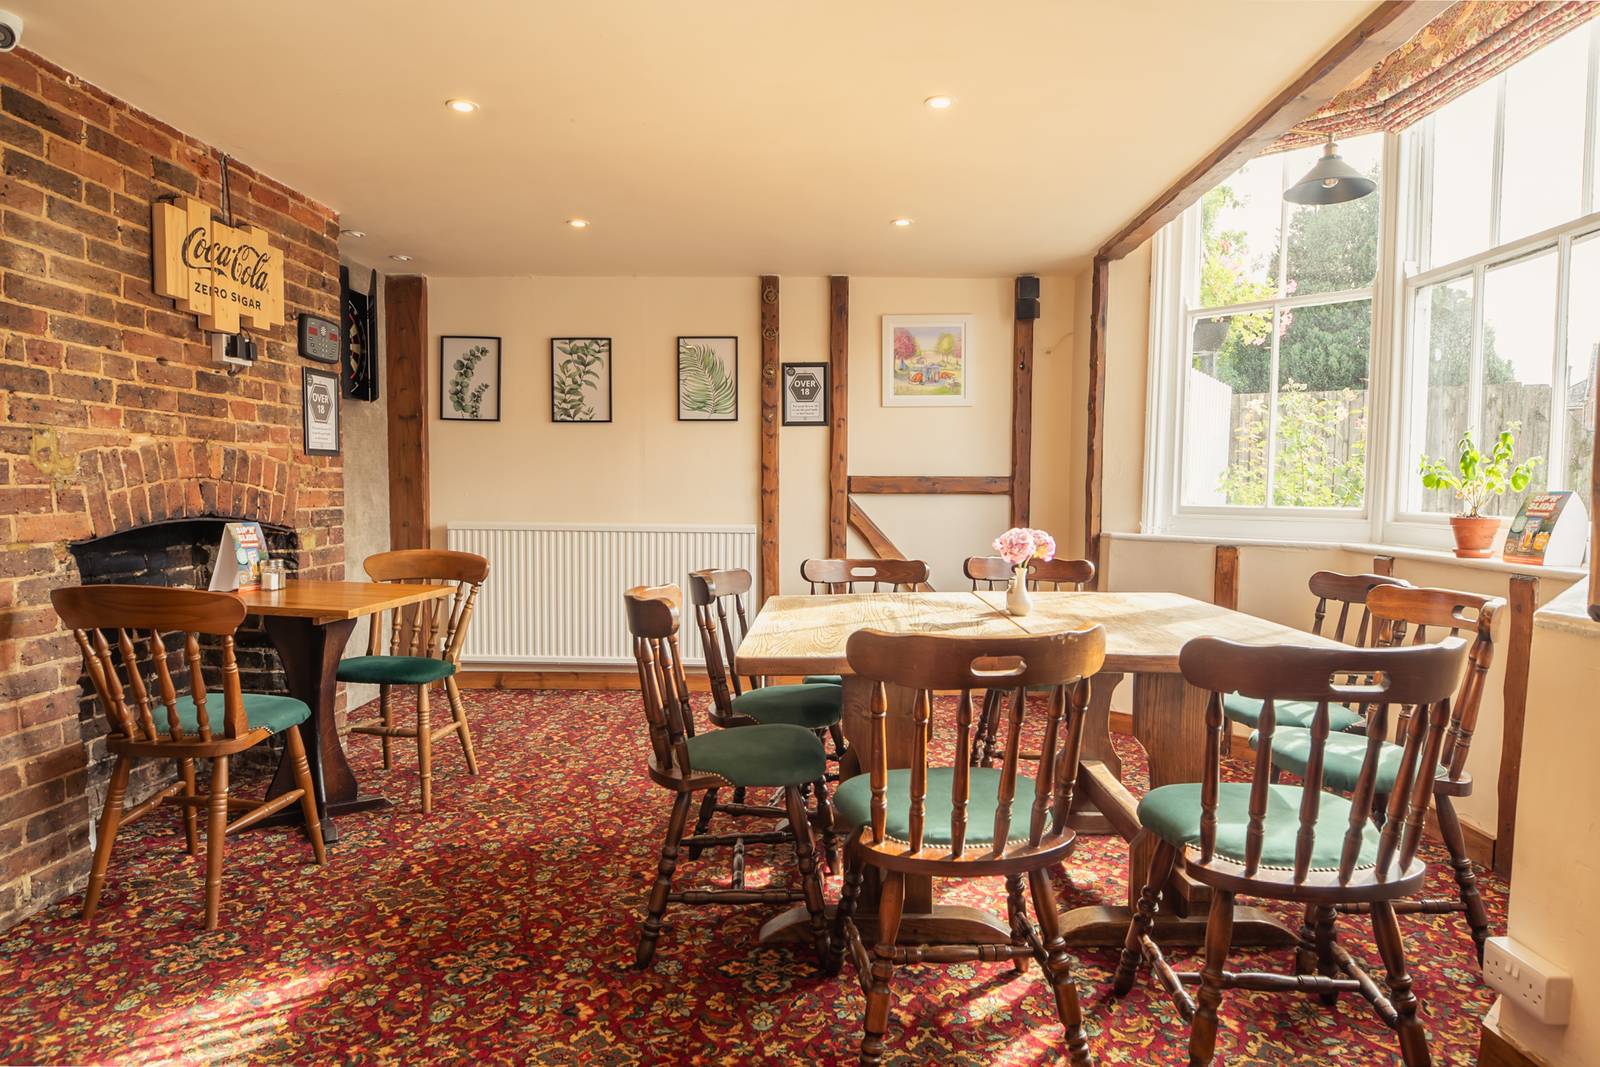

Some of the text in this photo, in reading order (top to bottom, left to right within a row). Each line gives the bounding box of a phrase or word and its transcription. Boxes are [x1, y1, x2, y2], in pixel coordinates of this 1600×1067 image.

[194, 282, 228, 299] ZERO
[794, 380, 816, 388] OVER
[800, 388, 810, 396] 18
[312, 393, 329, 404] OVER
[317, 405, 325, 414] 18
